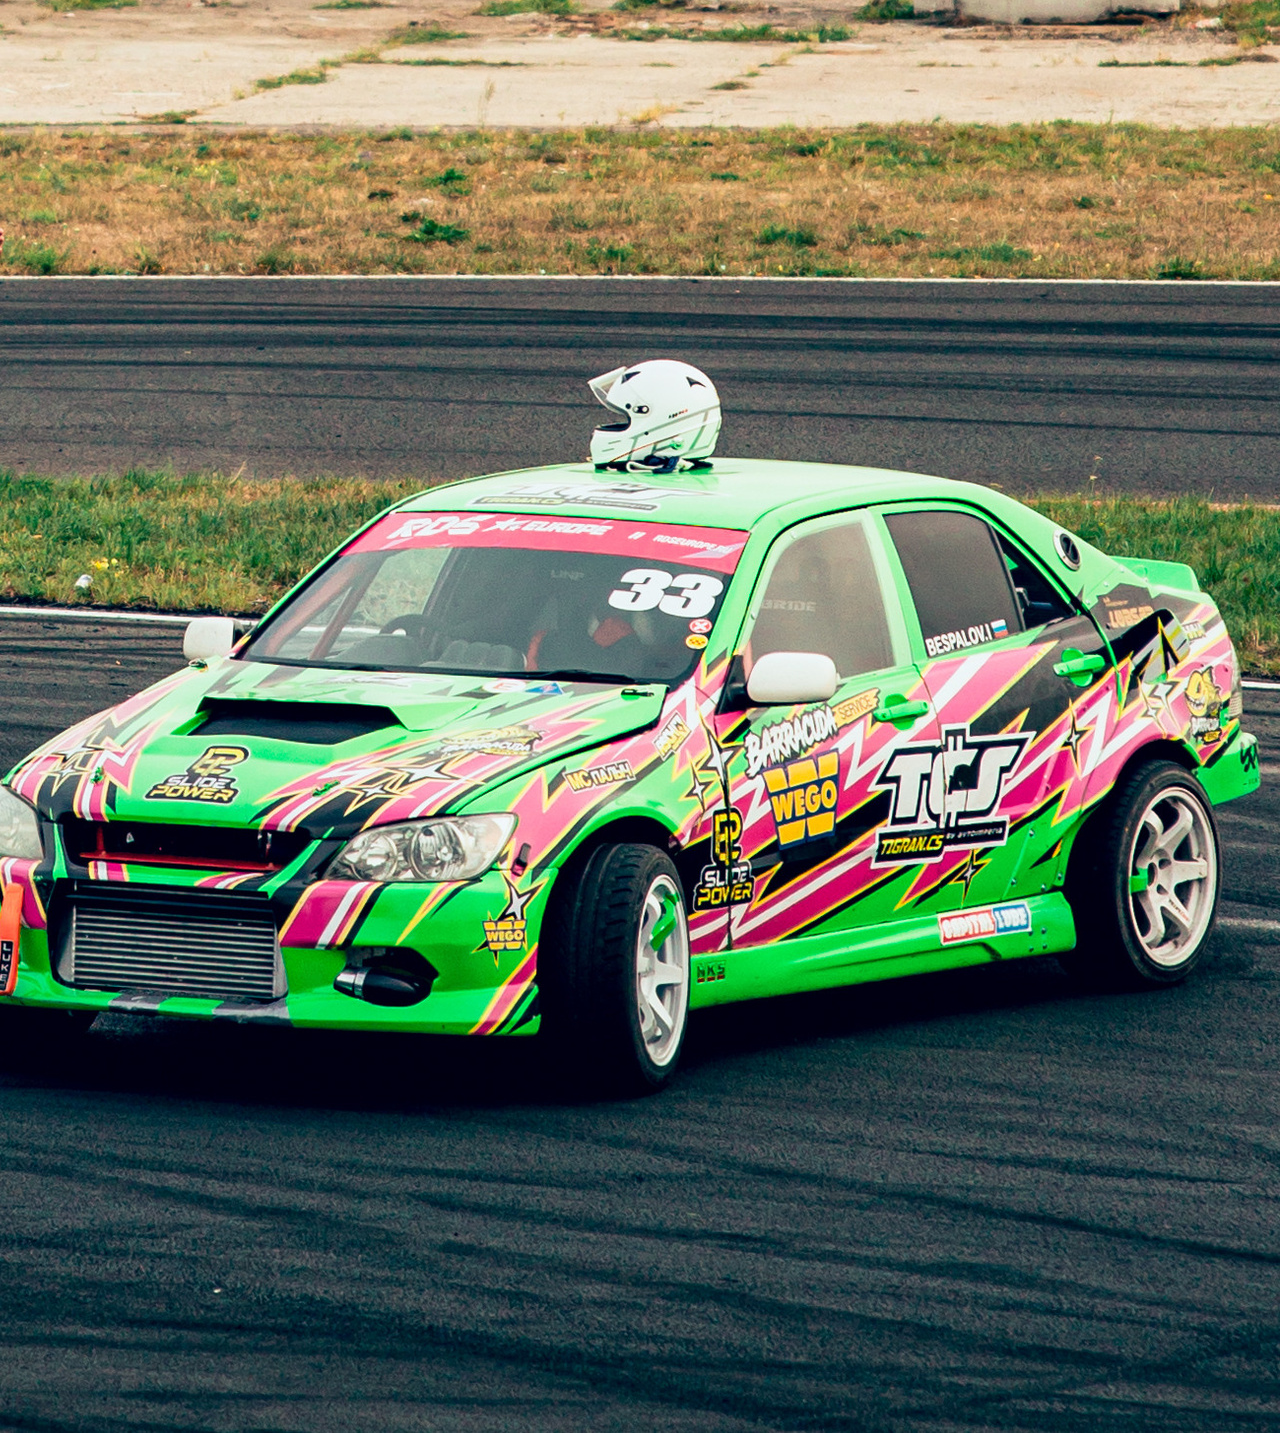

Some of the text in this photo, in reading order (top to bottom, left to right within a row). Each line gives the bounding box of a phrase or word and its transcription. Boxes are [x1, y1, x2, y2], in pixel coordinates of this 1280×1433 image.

[387, 516, 614, 540] RDS EUROPE
[608, 568, 724, 618] 33
[925, 623, 993, 658] BESPALOV.I
[744, 704, 839, 778] BARRACUDA
[837, 694, 874, 721] SERVICE
[148, 784, 236, 801] POWER
[165, 775, 232, 789] SLIDE
[771, 779, 838, 823] WEGO
[881, 834, 945, 856] TIGRAN.CS
[704, 865, 749, 888] SLIDE
[485, 929, 524, 942] WEGO
